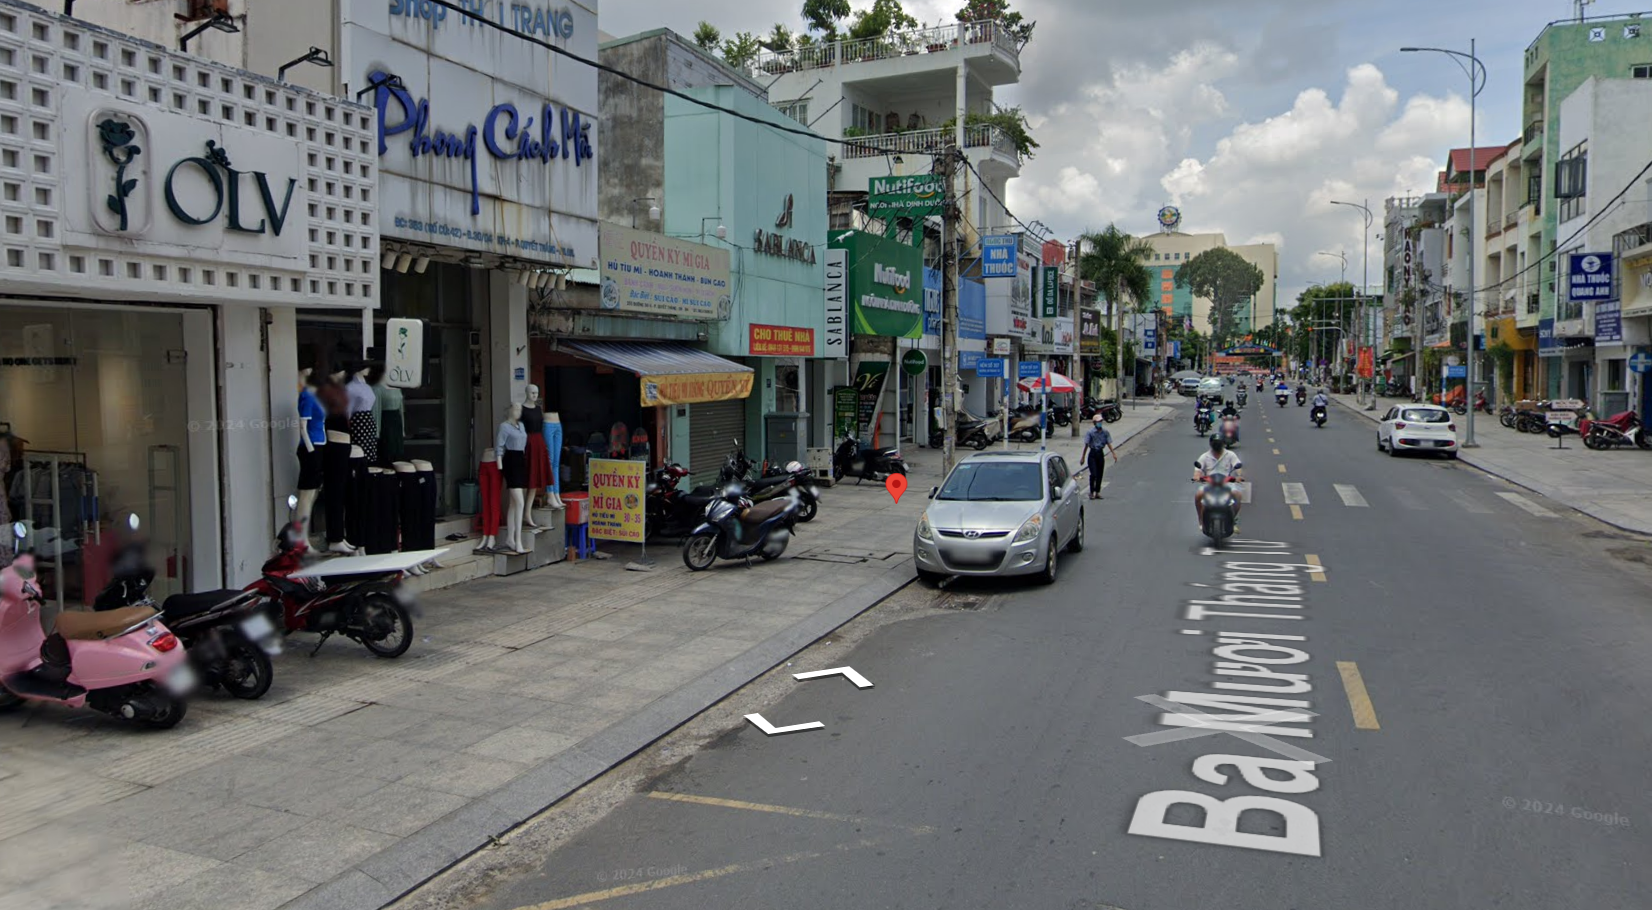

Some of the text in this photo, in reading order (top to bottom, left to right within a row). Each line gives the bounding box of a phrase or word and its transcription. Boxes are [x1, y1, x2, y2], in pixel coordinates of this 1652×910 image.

[511, 4, 574, 40] TRANG
[367, 70, 480, 216] Phong
[483, 103, 560, 165] Cách
[165, 156, 298, 237] OLV
[695, 253, 710, 271] GIA
[990, 247, 1008, 260] NHÀ
[984, 259, 1014, 275] THUỐC
[1571, 270, 1610, 284] NHÀ THUỐC
[1571, 286, 1610, 298] QUANG ANH
[826, 261, 842, 346] SABLANCA
[754, 328, 811, 343] CHO THUÊ NHÀ
[389, 367, 413, 382] OLV
[593, 467, 641, 489] QUYỀN KÝ
[592, 492, 623, 511] MÌ GIA
